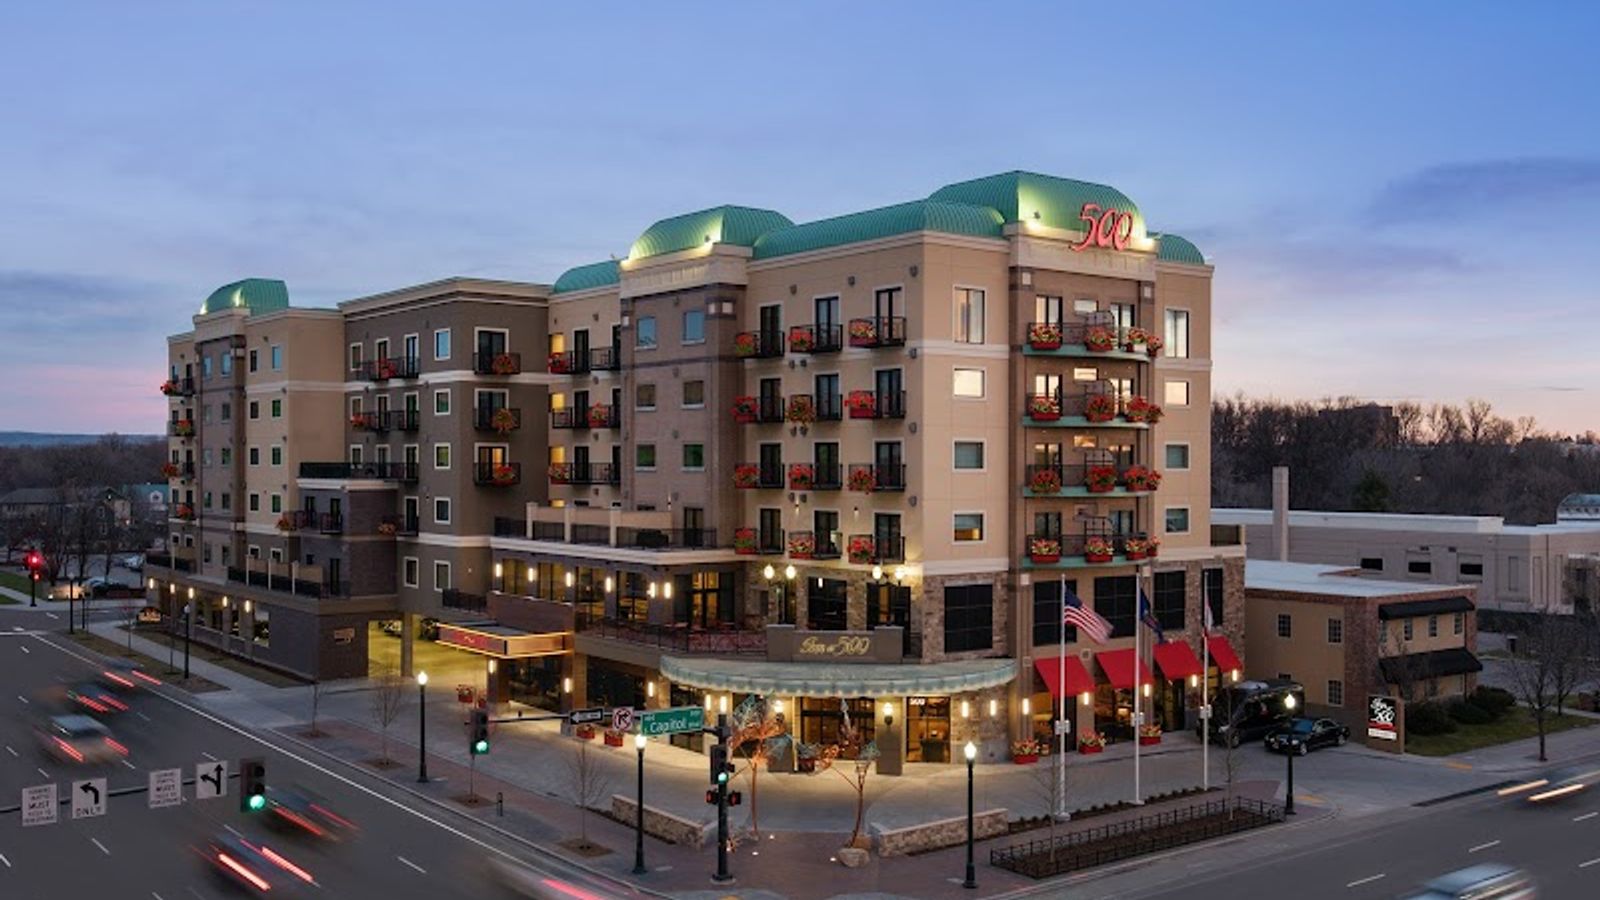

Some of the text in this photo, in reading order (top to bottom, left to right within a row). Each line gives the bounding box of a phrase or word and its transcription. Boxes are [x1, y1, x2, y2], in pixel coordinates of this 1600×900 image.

[1069, 203, 1133, 252] 500
[833, 636, 870, 656] 500
[650, 717, 687, 733] Capitol
[76, 806, 101, 817] ONLY
